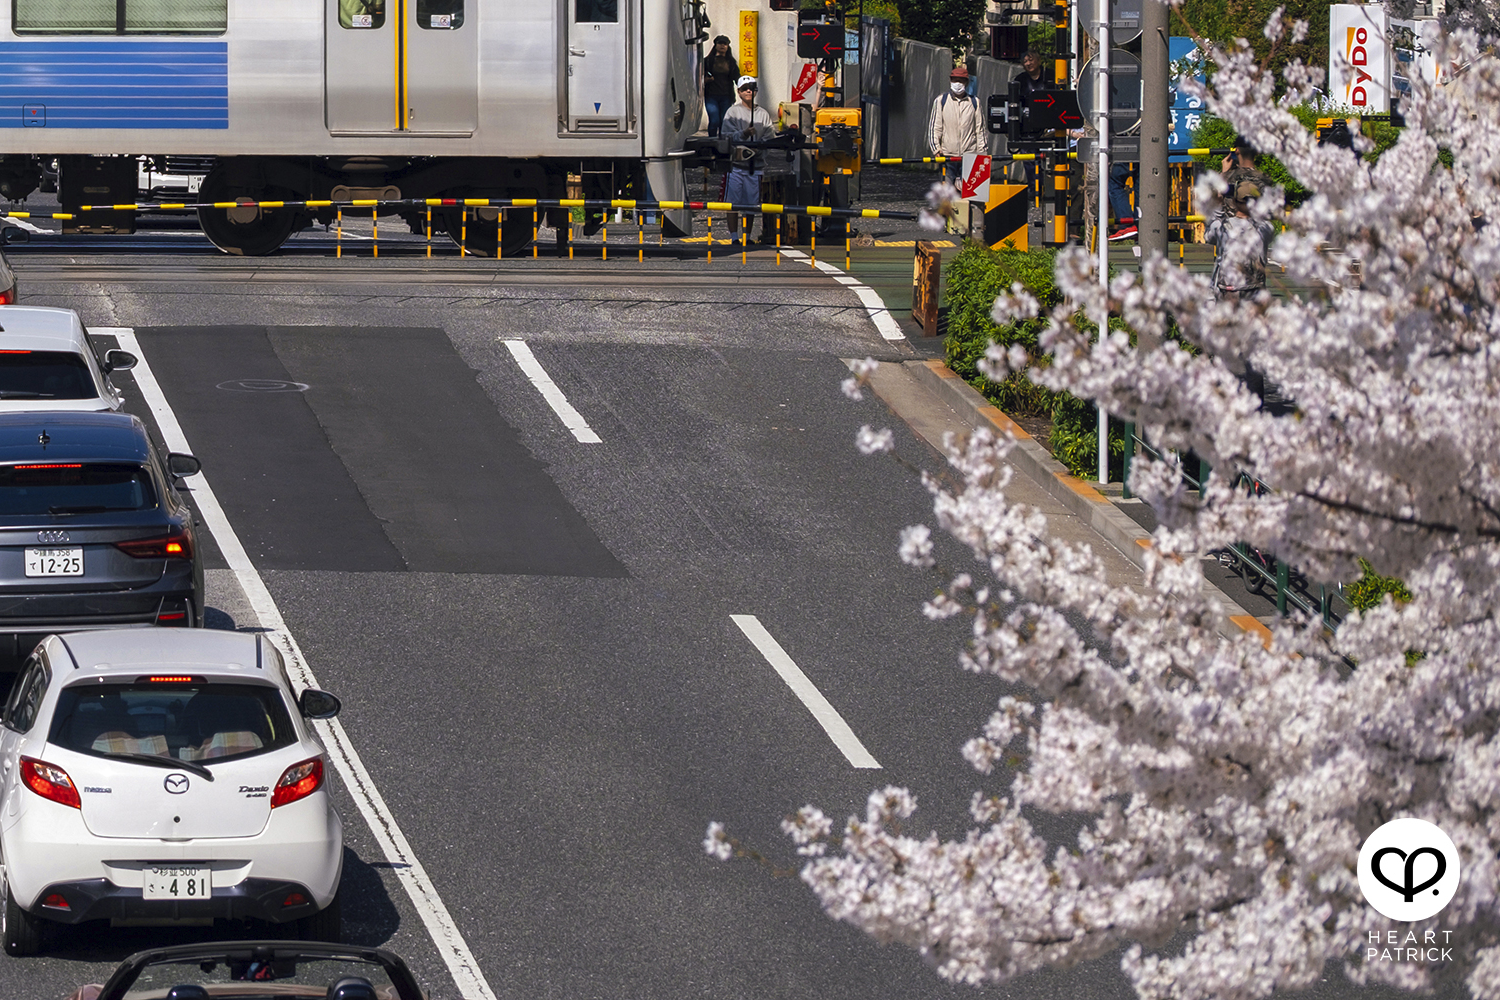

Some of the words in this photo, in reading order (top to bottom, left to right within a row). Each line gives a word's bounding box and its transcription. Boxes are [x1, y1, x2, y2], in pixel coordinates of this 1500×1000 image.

[743, 15, 754, 73] 段差注意
[1352, 27, 1372, 106] DyDo
[30, 562, 37, 570] て
[40, 558, 80, 573] 12-25
[160, 867, 178, 876] 杉並
[180, 867, 197, 876] 500
[149, 883, 155, 893] さ
